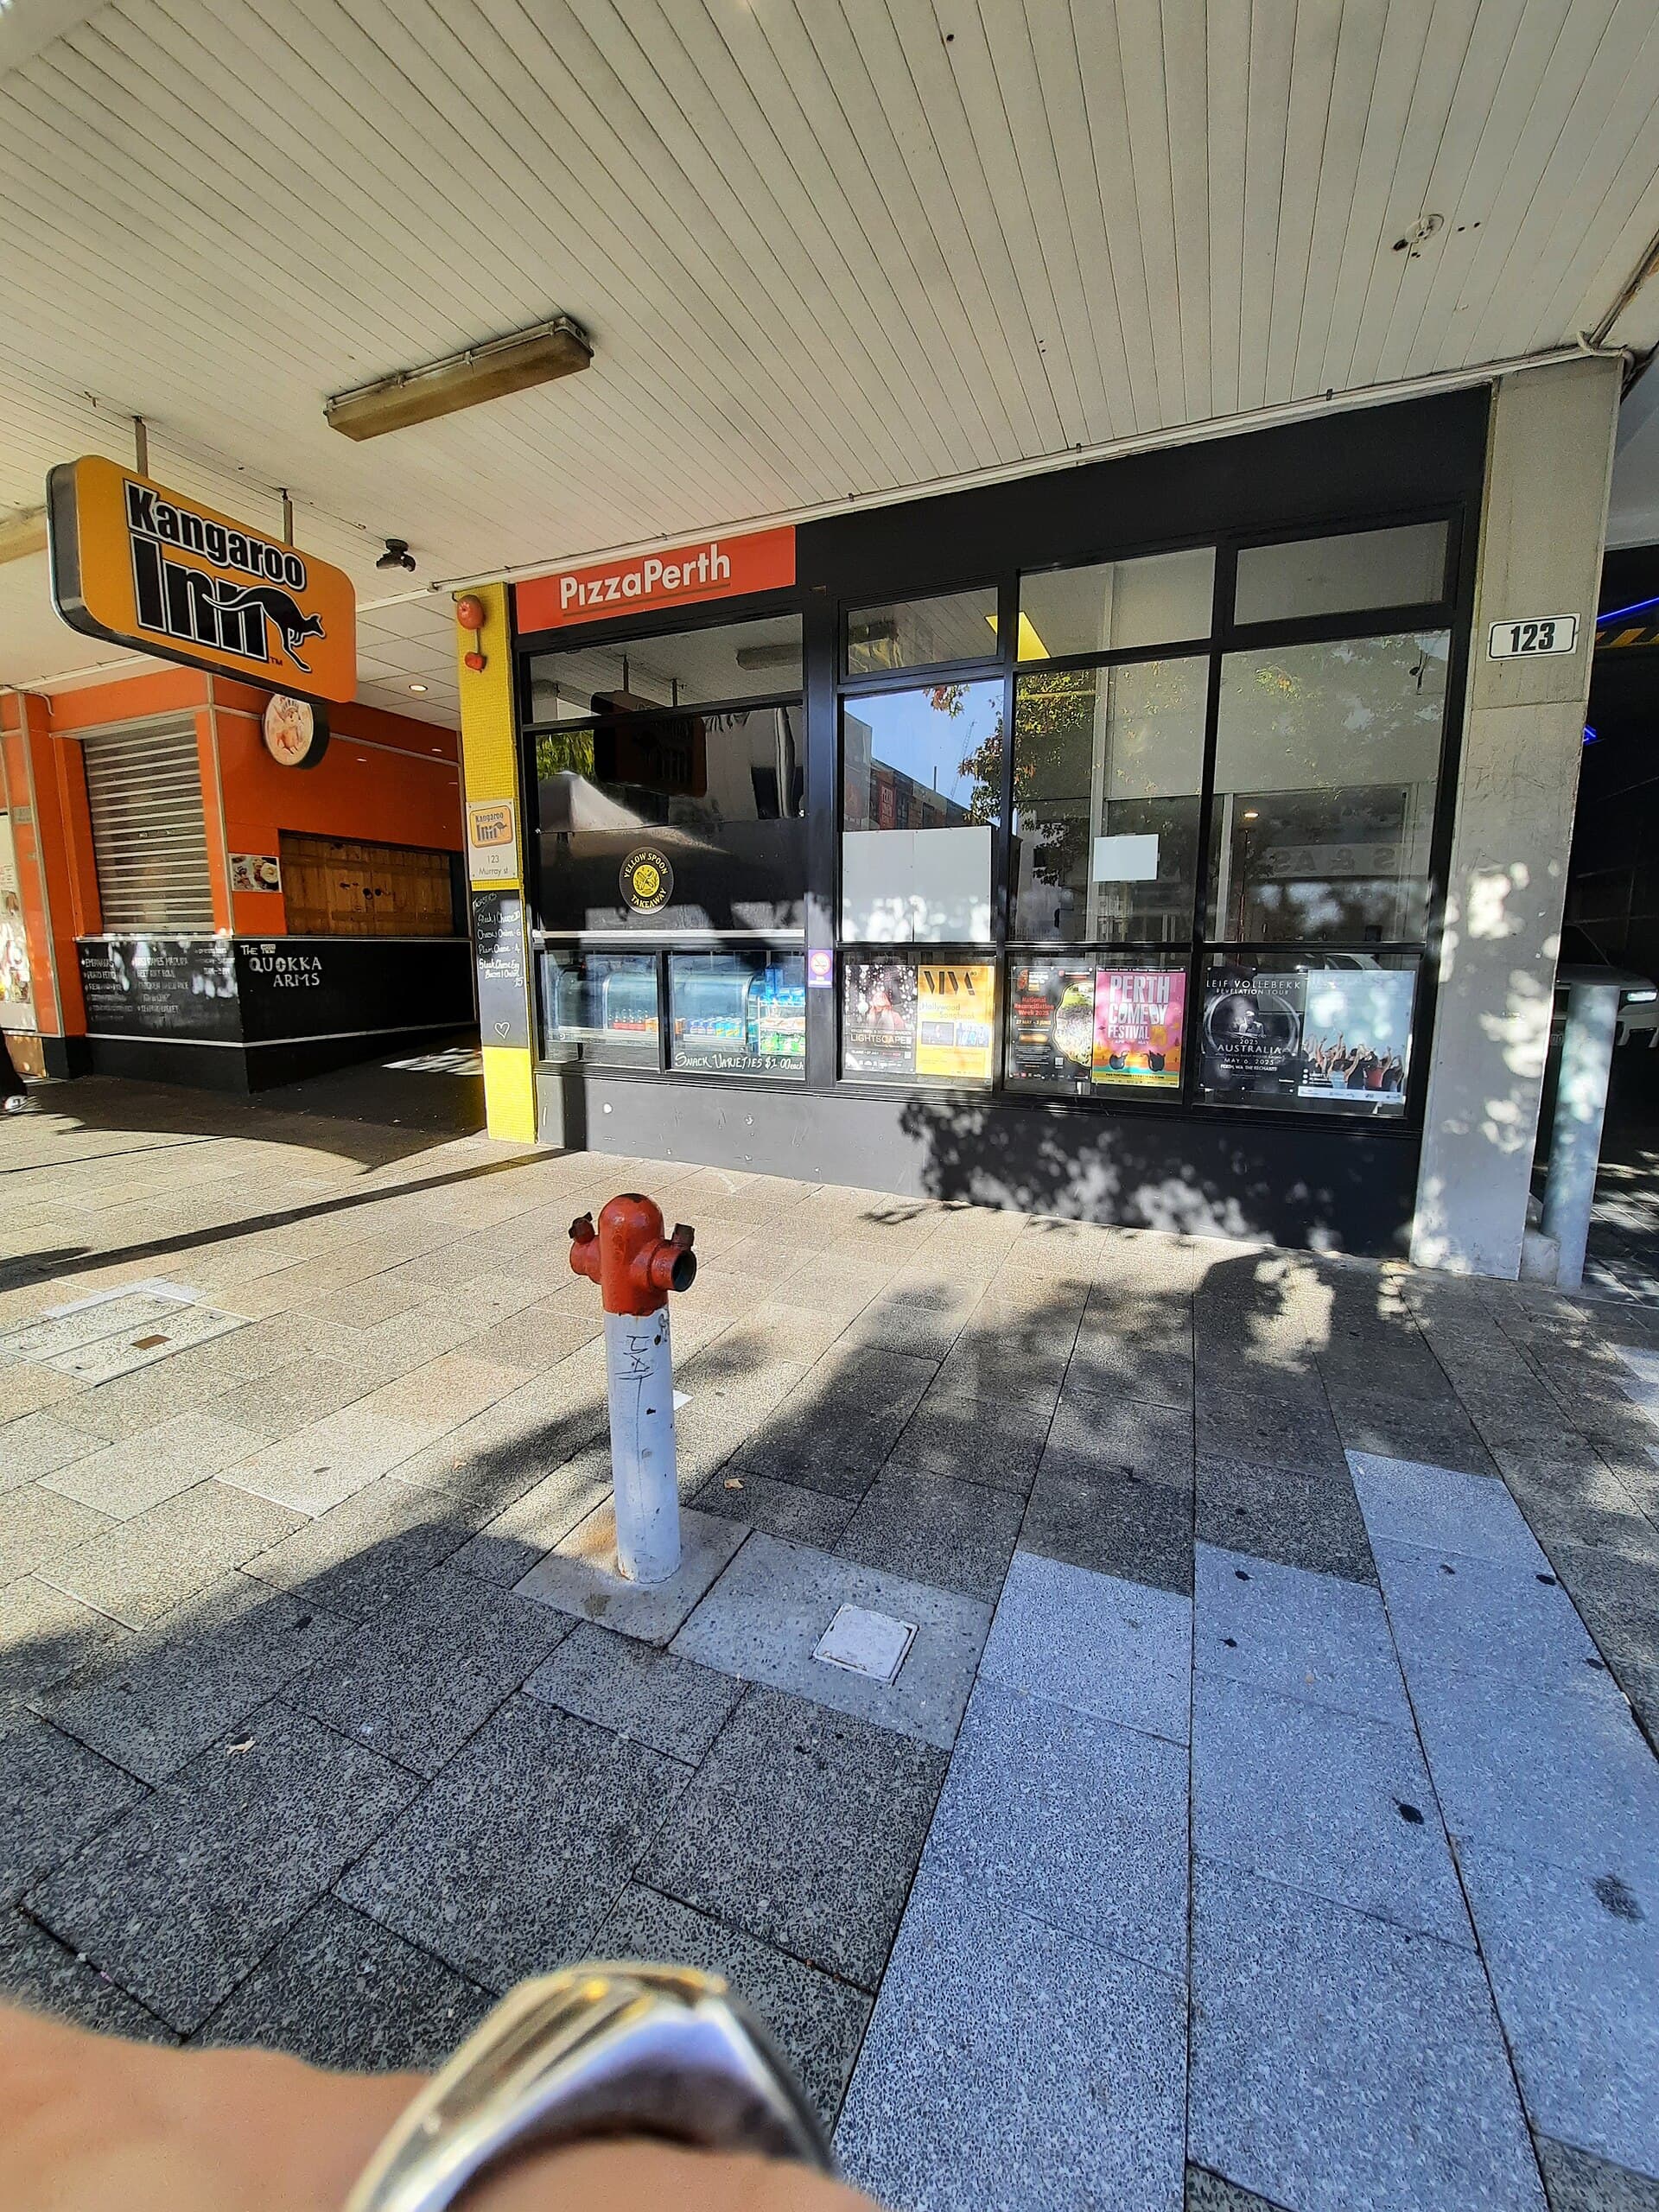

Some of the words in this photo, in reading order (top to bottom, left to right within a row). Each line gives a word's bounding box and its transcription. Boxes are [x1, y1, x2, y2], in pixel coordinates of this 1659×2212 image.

[124, 479, 307, 592] Kangaroo
[561, 543, 731, 610] PizzaPerth
[130, 531, 268, 664] Inn
[1510, 621, 1556, 652] 123
[475, 812, 504, 823] Kangaroo
[486, 855, 499, 864] 123
[624, 852, 646, 879] YELLOW
[647, 852, 669, 875] SPOON
[479, 867, 502, 877] Murray
[631, 887, 667, 909] TAKEAWAY
[240, 944, 258, 955] THE
[248, 956, 322, 973] QUOKKA
[273, 972, 321, 987] ARMS
[1234, 980, 1301, 989] VOLLEBEKK
[1110, 975, 1171, 1003] PERTH
[1216, 988, 1264, 996] REVELATION
[1109, 1002, 1168, 1026] COMEDY
[850, 1033, 906, 1045] LIGHTSCAPE
[1107, 1024, 1150, 1040] FESTIVAL
[1217, 1044, 1282, 1054] AUSTRALIA
[675, 1052, 712, 1068] SNACK
[712, 1053, 762, 1070] VARIETIES
